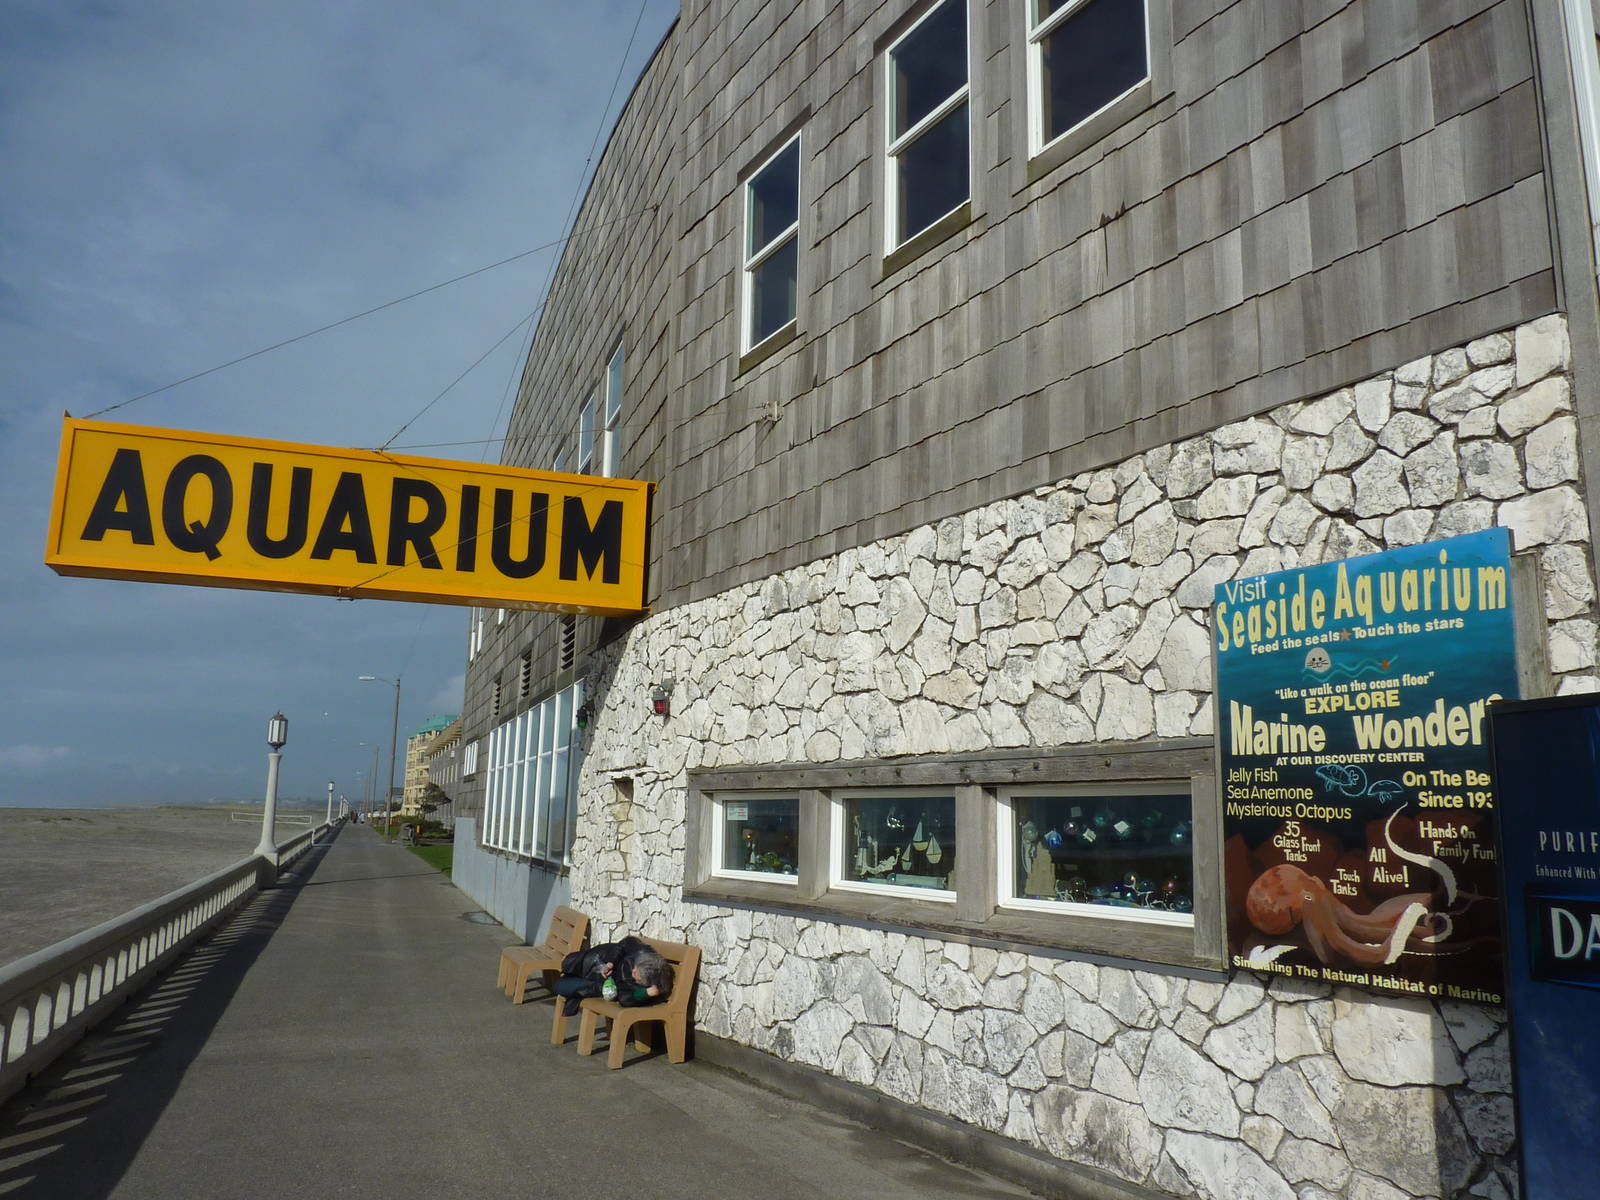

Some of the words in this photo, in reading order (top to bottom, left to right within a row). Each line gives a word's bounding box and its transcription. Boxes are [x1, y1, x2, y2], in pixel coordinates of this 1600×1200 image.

[80, 448, 624, 585] AQUARIUM
[1225, 576, 1267, 605] Visit
[1216, 573, 1326, 652] Seaside
[1333, 548, 1507, 626] Aquarium
[1251, 641, 1280, 655] Feed
[1282, 637, 1302, 649] the
[1305, 630, 1340, 646] seals
[1352, 624, 1395, 639] Touch
[1398, 620, 1421, 634] the
[1425, 617, 1465, 632] stars
[1300, 688, 1307, 697] a
[1309, 683, 1333, 696] walk
[1335, 683, 1348, 693] on
[1350, 680, 1367, 692] the
[1369, 677, 1400, 690] ocean
[1304, 689, 1401, 715] EXPLORE
[1230, 699, 1327, 756] Marine
[1352, 693, 1504, 750] Wonder
[1276, 757, 1289, 766] AT
[1290, 756, 1313, 765] OUR
[1314, 753, 1375, 765] DISCOVERY
[1377, 752, 1425, 763] CENTER
[1227, 767, 1252, 786] Jelly
[1254, 767, 1278, 782] Fish
[1402, 770, 1427, 787] On
[1430, 769, 1462, 787] The
[1465, 769, 1491, 787] Be
[1227, 785, 1250, 799] Sea
[1250, 785, 1313, 800] Anemone
[1418, 790, 1463, 808] Since
[1227, 802, 1293, 820] Mysterious
[1295, 803, 1352, 823] Octopus
[1284, 821, 1301, 838] 35
[1419, 821, 1458, 839] Hands
[1460, 824, 1476, 839] On
[1273, 835, 1300, 849] Glass
[1301, 836, 1321, 853] Front
[1433, 841, 1470, 865] Family
[1283, 849, 1308, 862] Tanks
[1369, 846, 1387, 864] All
[1336, 868, 1361, 883] Touch
[1372, 865, 1410, 888] Alive!
[1535, 864, 1573, 878] Enhanced
[1574, 866, 1597, 880] With
[1330, 879, 1358, 896] Tanks
[1232, 955, 1293, 977] Simating
[1295, 964, 1319, 978] The
[1322, 968, 1370, 985] Natural
[1372, 974, 1426, 993] Habitat
[1428, 983, 1444, 996] of
[1447, 984, 1502, 1004] Marine
